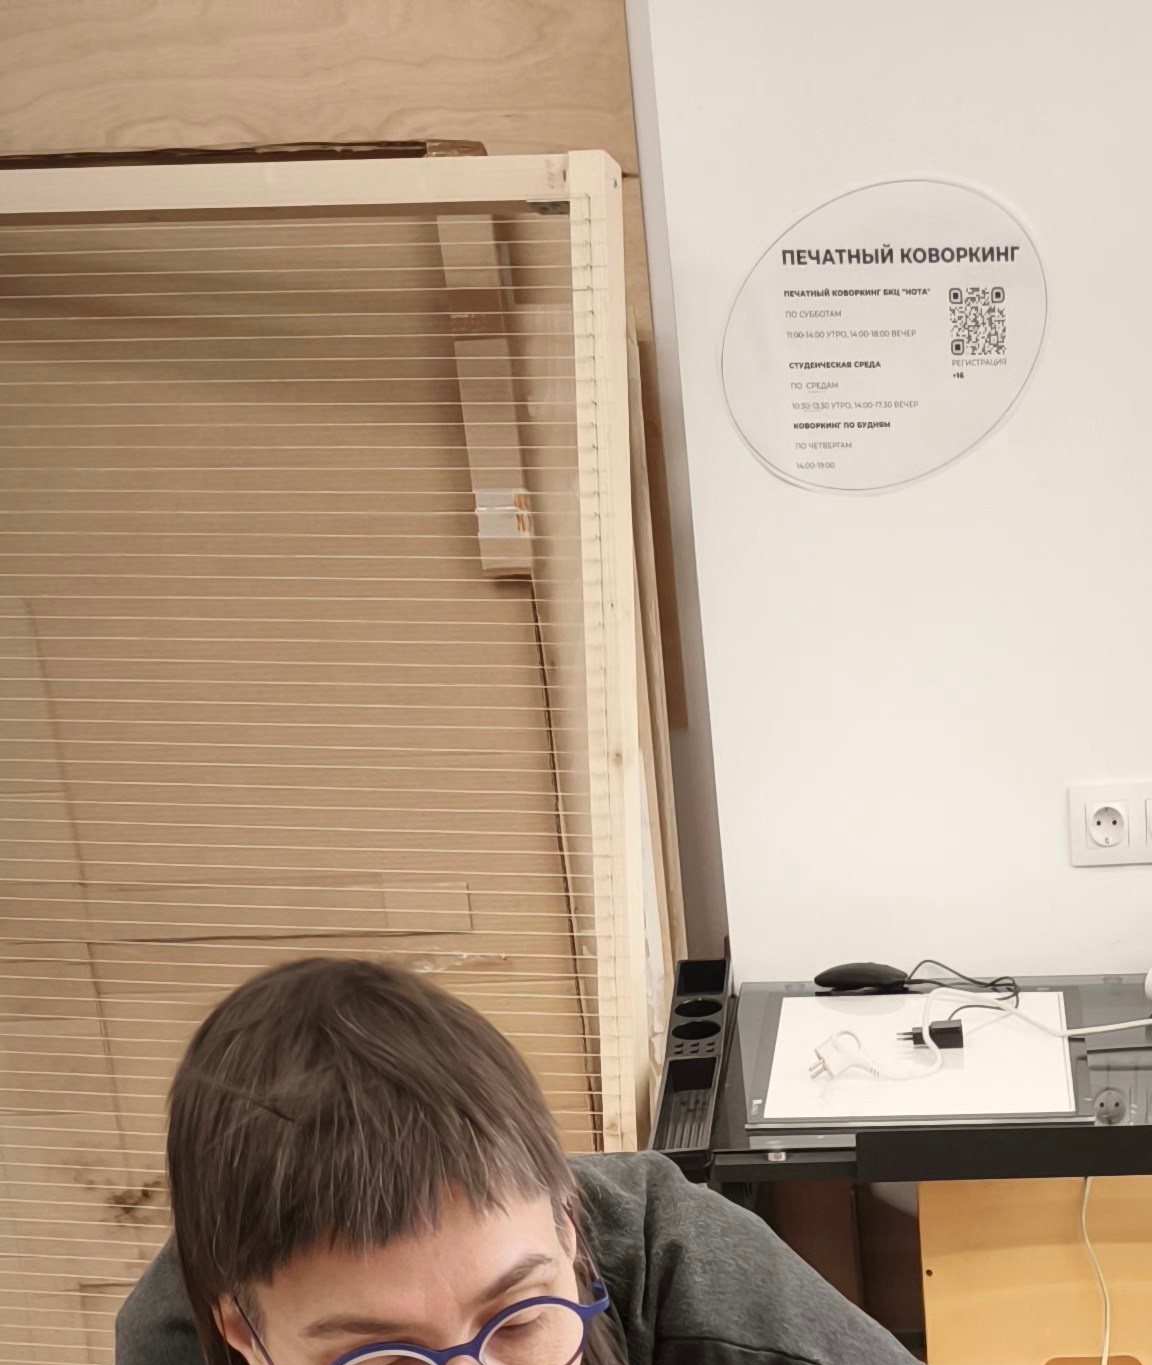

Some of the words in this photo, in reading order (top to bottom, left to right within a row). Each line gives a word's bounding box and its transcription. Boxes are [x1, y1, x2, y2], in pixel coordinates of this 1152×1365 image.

[781, 243, 894, 265] ПЕЧАТНЫЙ
[900, 246, 1020, 264] КОВОРКИНГ
[783, 287, 830, 298] ПЕЧАТНЫЙ
[832, 288, 881, 297] КОВОРКИНГ
[883, 288, 900, 297] БКЦ
[902, 288, 931, 296] "НОТА"
[785, 310, 798, 319] ПО
[799, 310, 842, 319] СУББОТАМ
[891, 329, 917, 338] ВЕЧЕР
[788, 361, 852, 370] СТУДЕНЧЕСКАЯ
[853, 361, 881, 369] СРЕДА
[951, 358, 1007, 368] РЕГИСТРАЦИЯ
[790, 382, 803, 390] ПО
[805, 381, 839, 390] СРЕДАМ
[894, 400, 919, 409] ВЕЧЕР
[793, 421, 842, 430] КОВОРКИНГ
[843, 421, 855, 430] ПО
[856, 420, 891, 430] БУДНЯМ
[794, 442, 807, 450] ПО
[808, 441, 853, 450] ЧЕТВЕРГАМ
